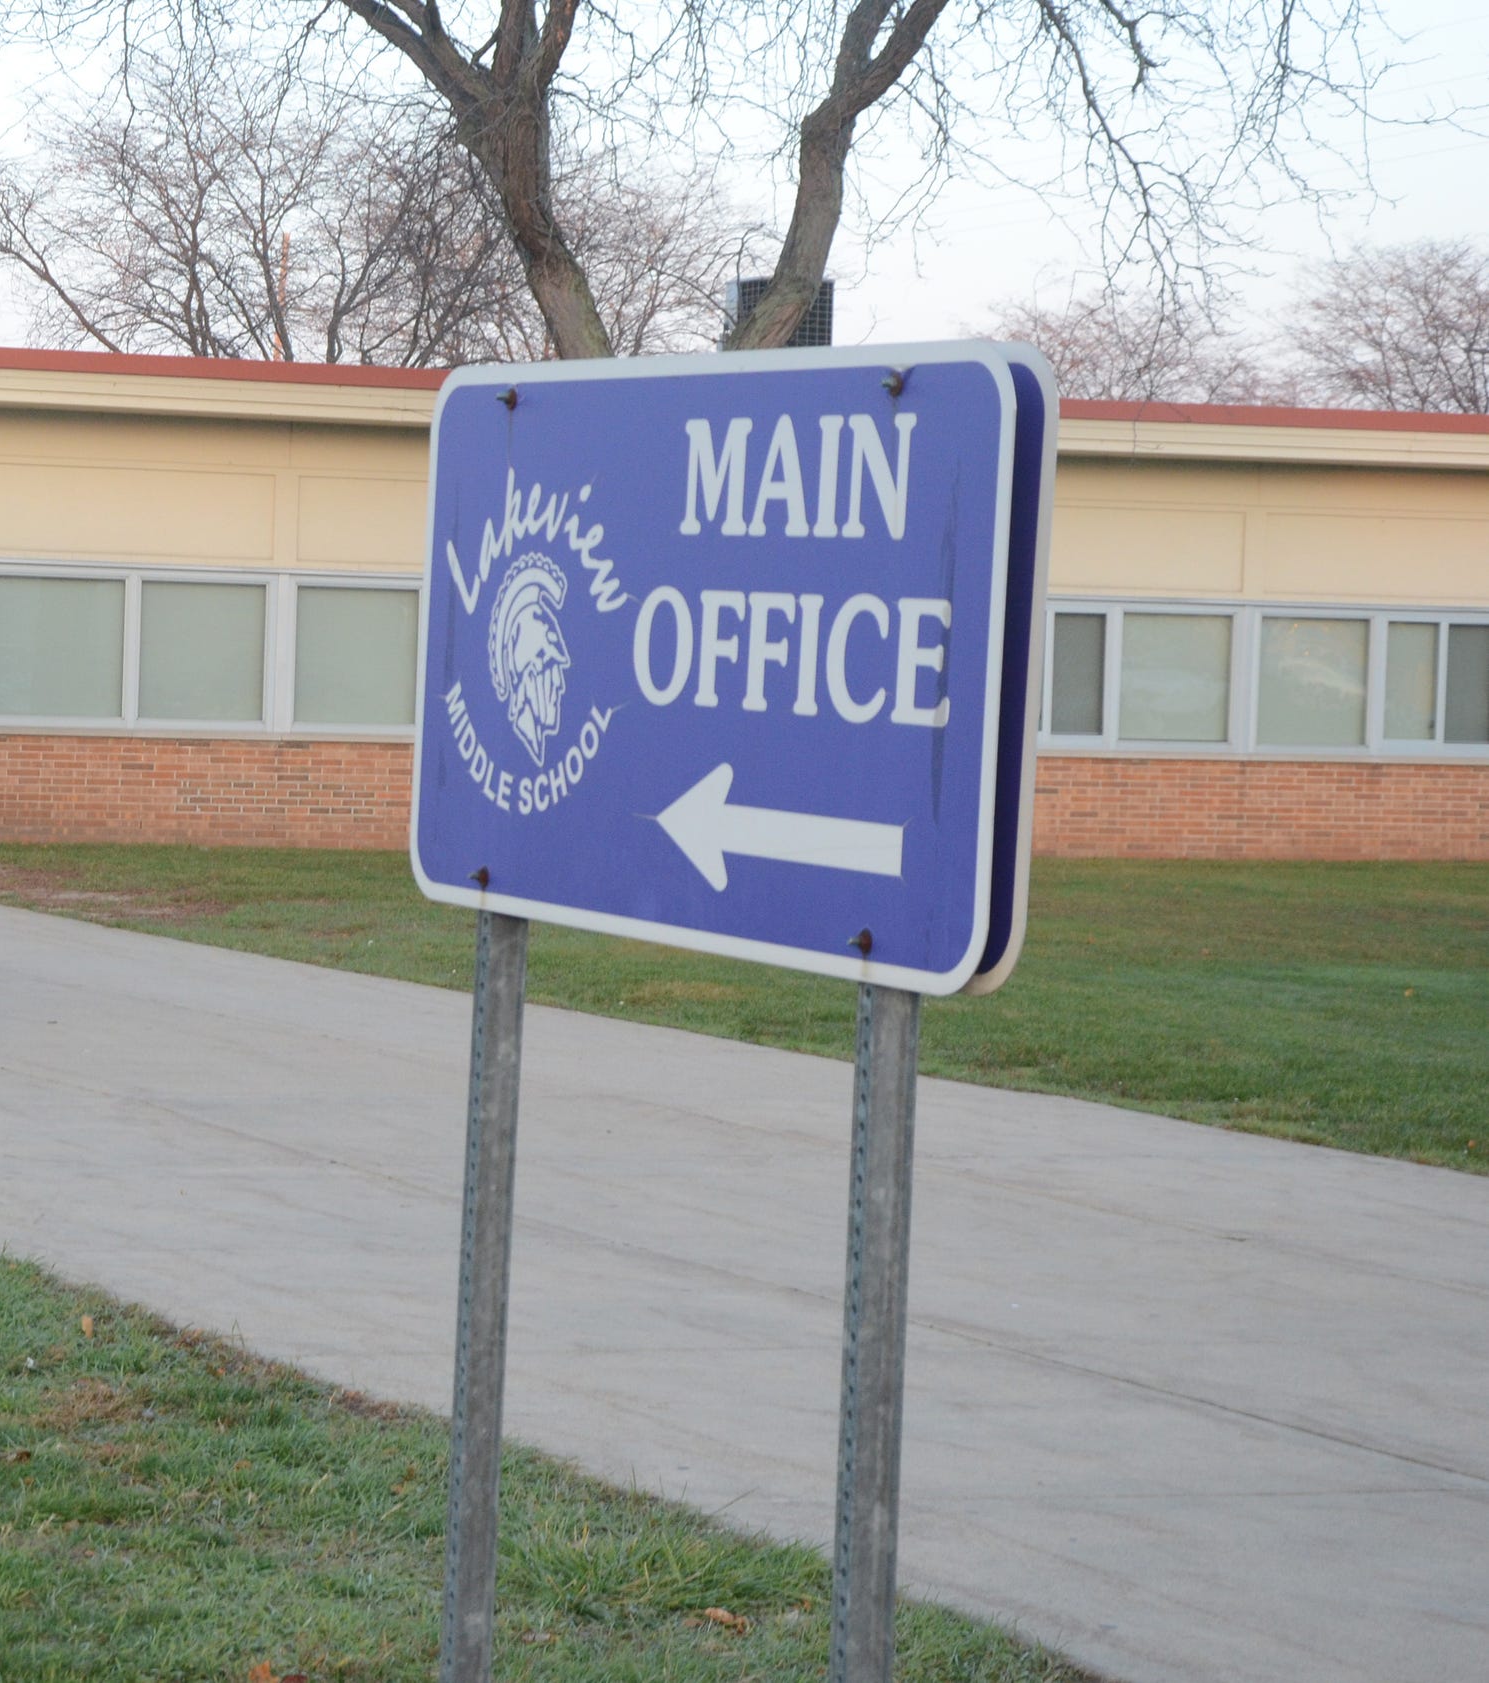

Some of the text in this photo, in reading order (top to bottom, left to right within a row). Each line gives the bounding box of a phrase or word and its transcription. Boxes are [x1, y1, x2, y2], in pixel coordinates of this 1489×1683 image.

[446, 466, 628, 615] Lakeview
[679, 412, 918, 541] MAIN
[633, 585, 952, 728] OFFICE
[445, 680, 612, 815] MIDDLE SCHOOL
